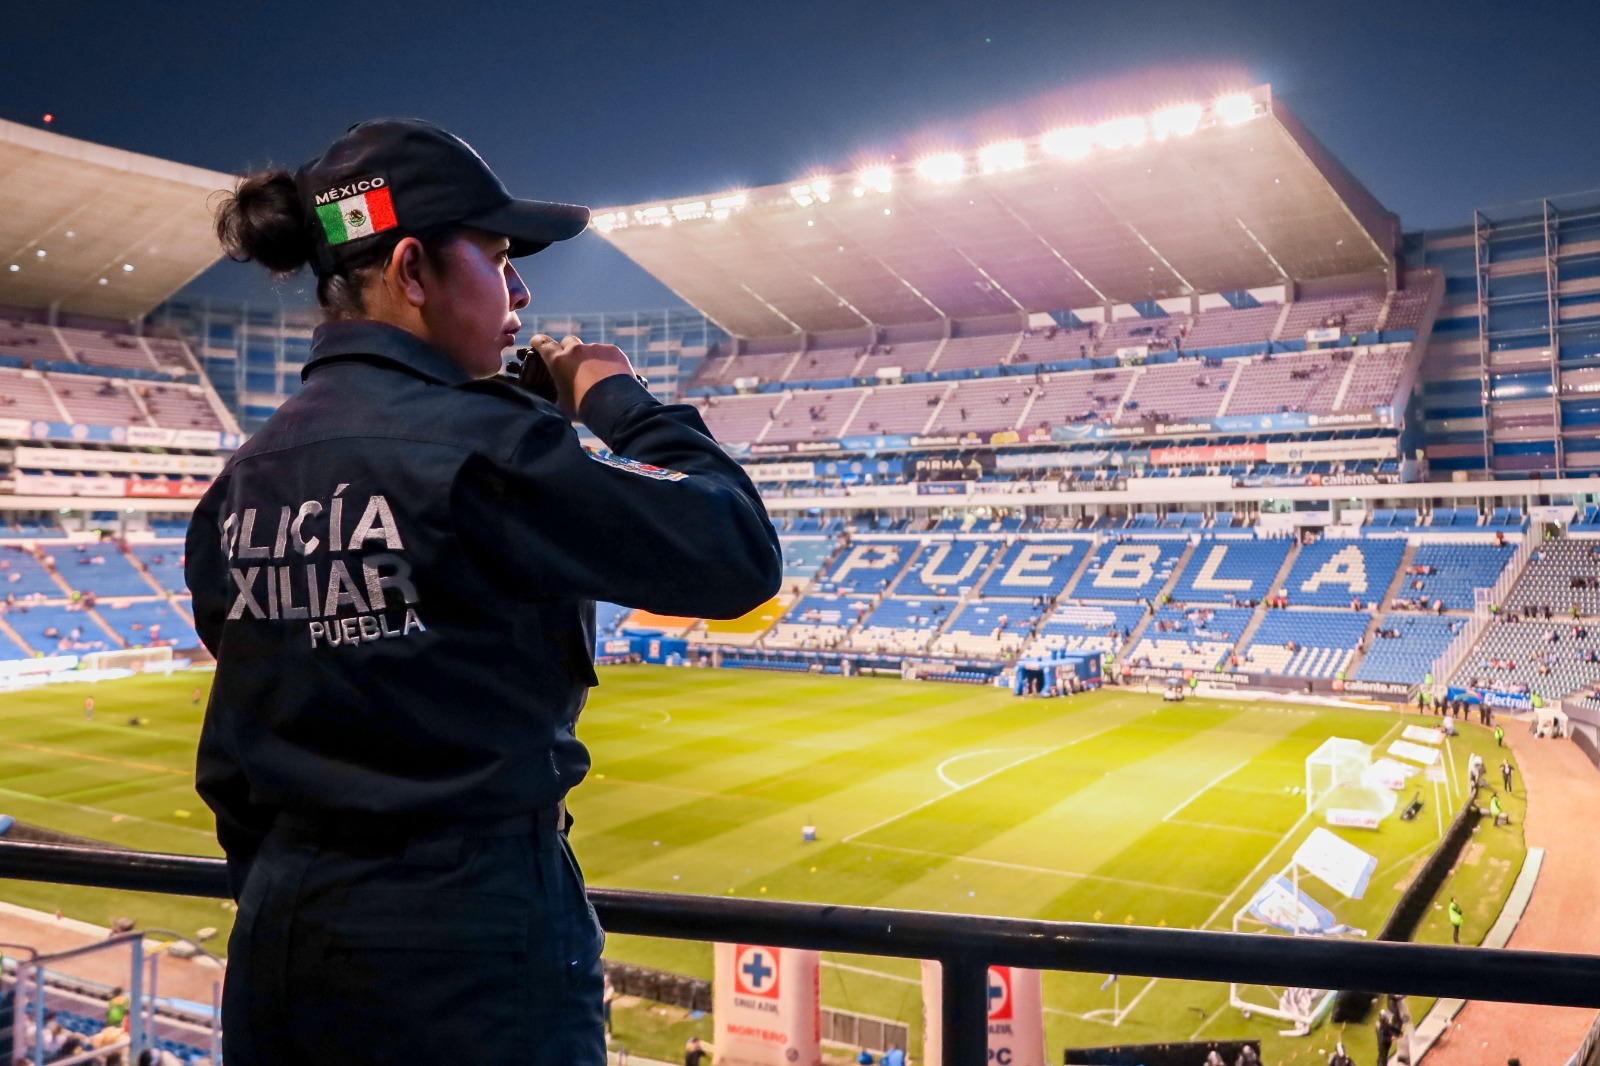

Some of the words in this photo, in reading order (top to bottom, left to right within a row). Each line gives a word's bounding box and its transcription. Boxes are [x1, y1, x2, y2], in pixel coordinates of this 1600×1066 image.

[315, 177, 385, 205] MÉXICO
[916, 460, 964, 471] PIRMA
[831, 543, 1368, 593] PUEBLA
[309, 608, 427, 648] PUEBLA
[1194, 671, 1250, 684] caliente.mx
[1344, 680, 1408, 694] caliente.mx
[727, 1024, 788, 1045] MORTERO
